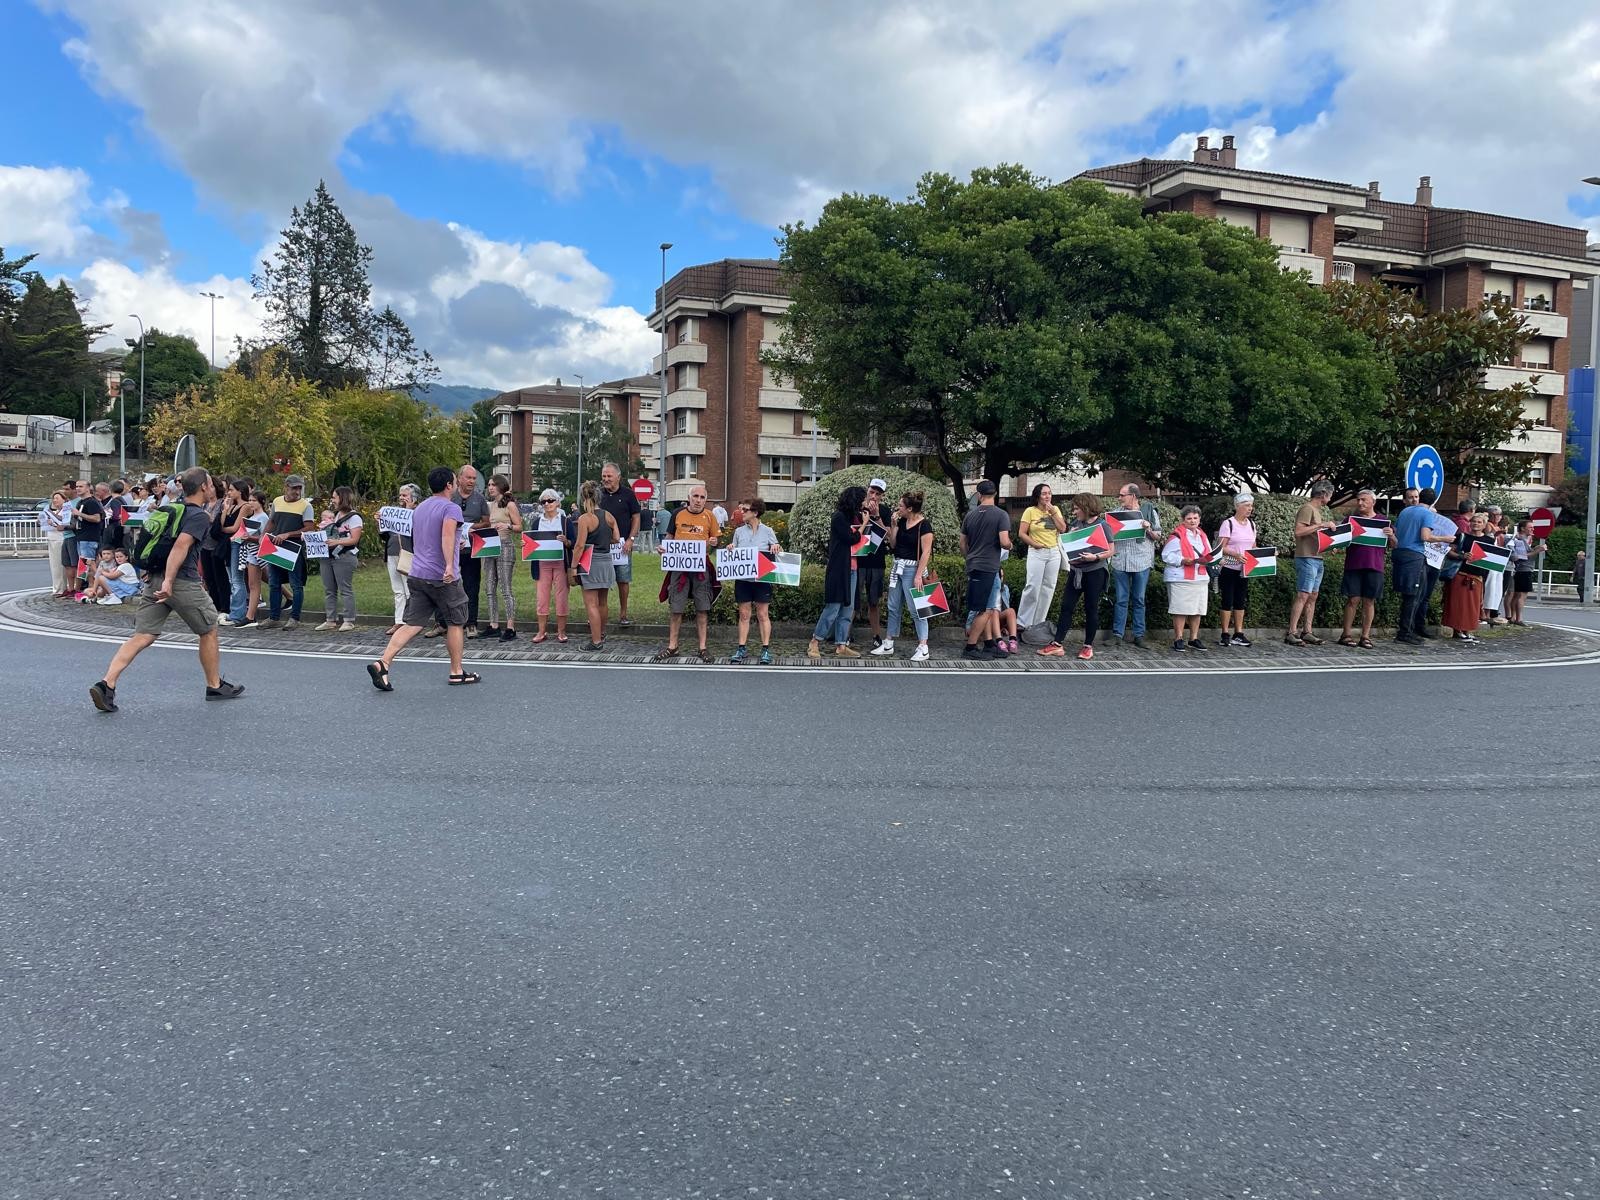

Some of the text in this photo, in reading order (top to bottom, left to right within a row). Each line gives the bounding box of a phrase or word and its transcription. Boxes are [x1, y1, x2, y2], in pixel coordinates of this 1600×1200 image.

[381, 508, 411, 520] ISRAELI
[666, 542, 700, 554] ISRAELI
[720, 549, 753, 562] ISRAELI
[662, 556, 705, 569] BOIKOTA
[717, 564, 757, 578] BOIKOTA
